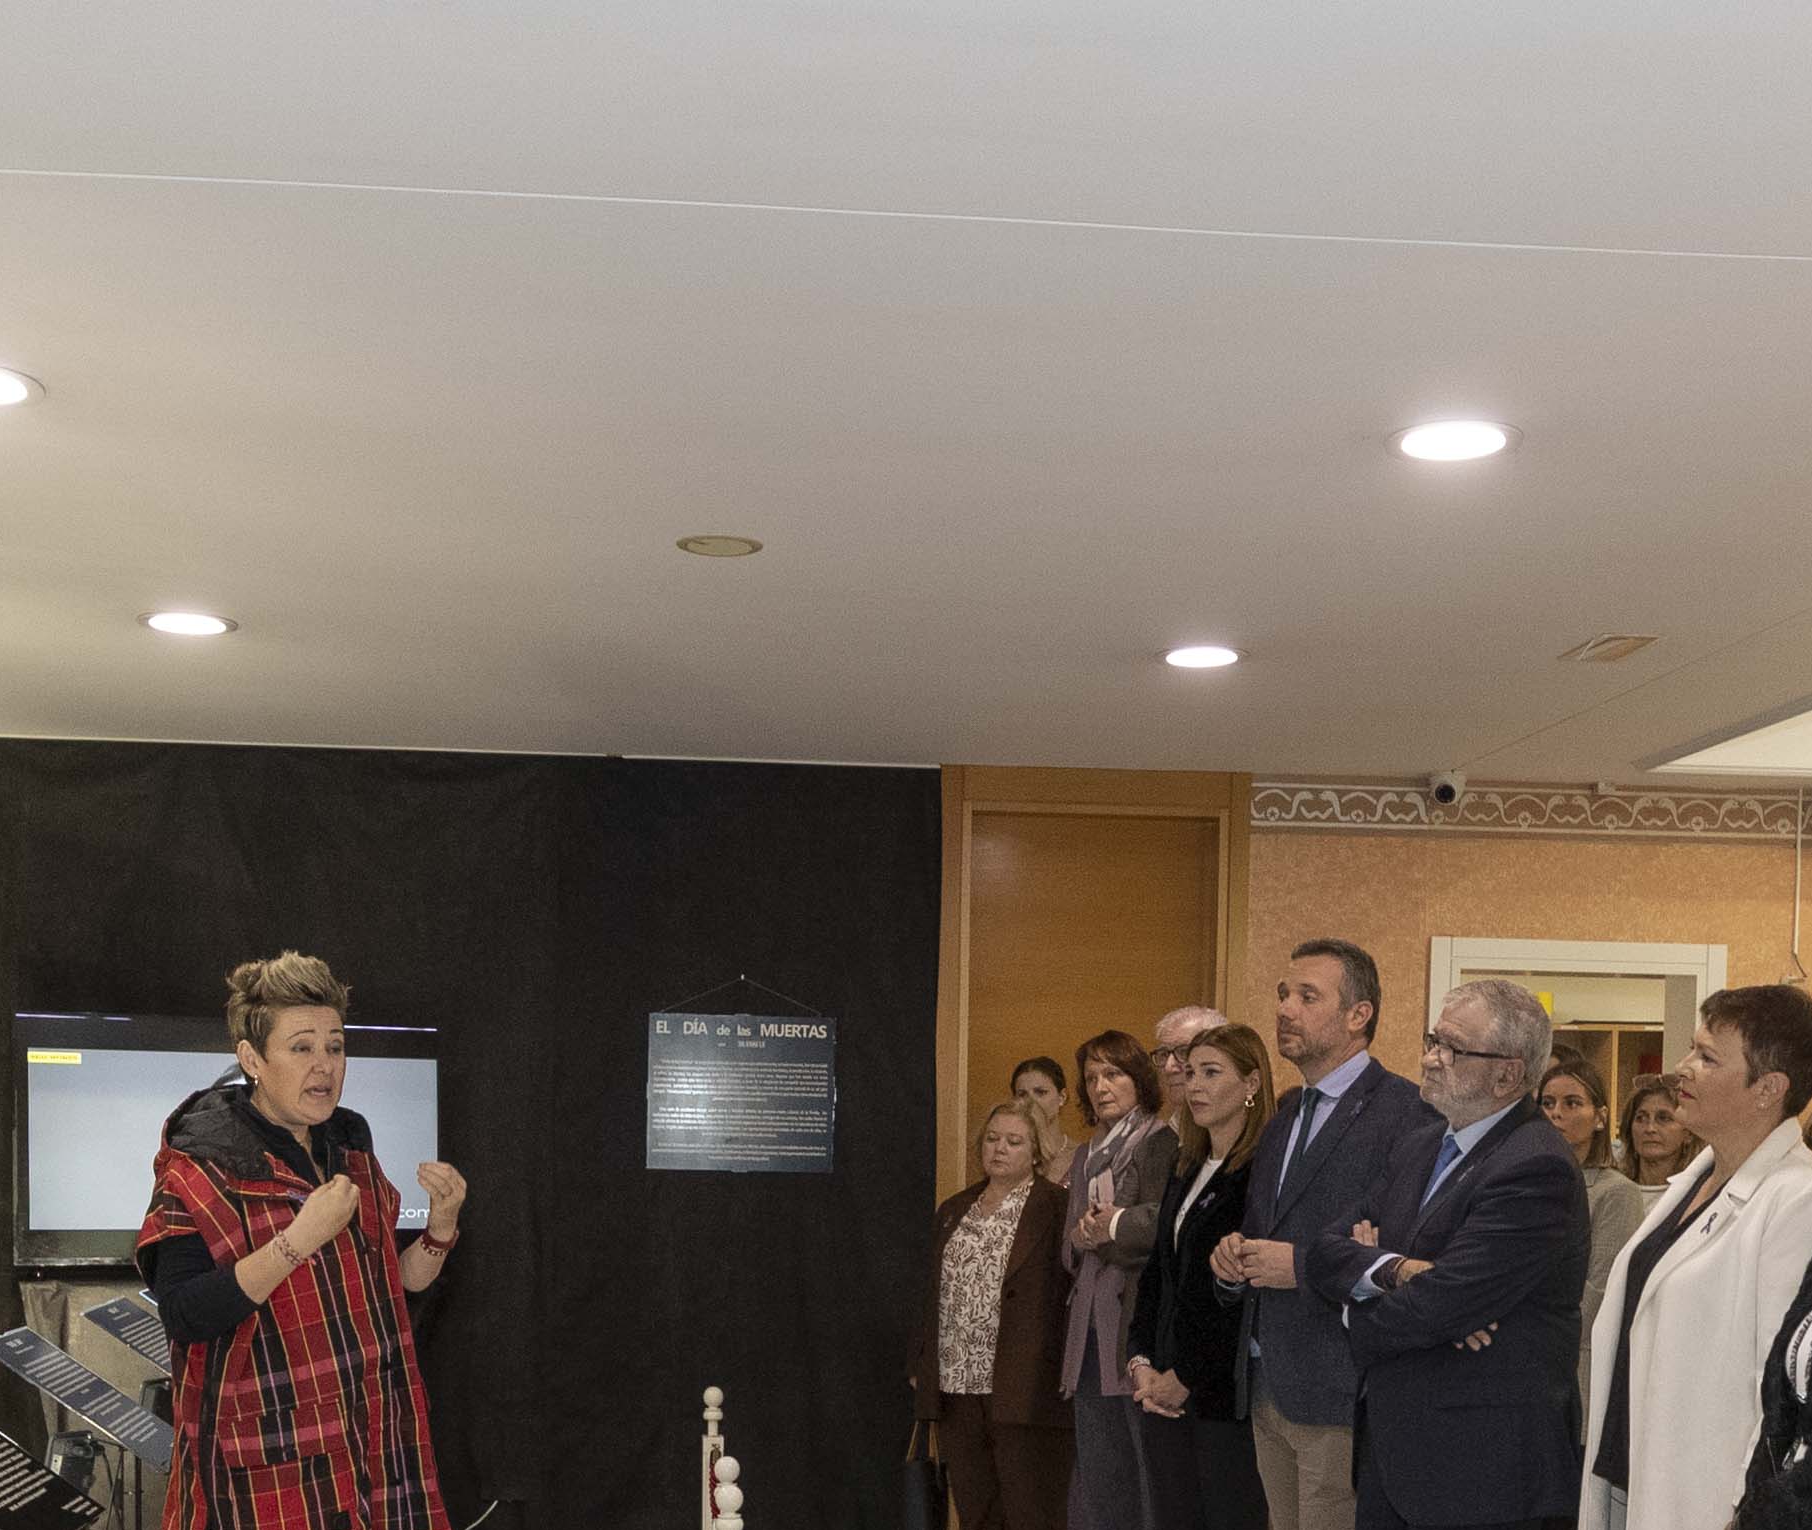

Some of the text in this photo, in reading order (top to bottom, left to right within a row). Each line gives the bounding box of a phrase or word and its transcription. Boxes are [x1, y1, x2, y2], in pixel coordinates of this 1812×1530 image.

[656, 1018, 828, 1038] EL DÍA de las MUERTAS
